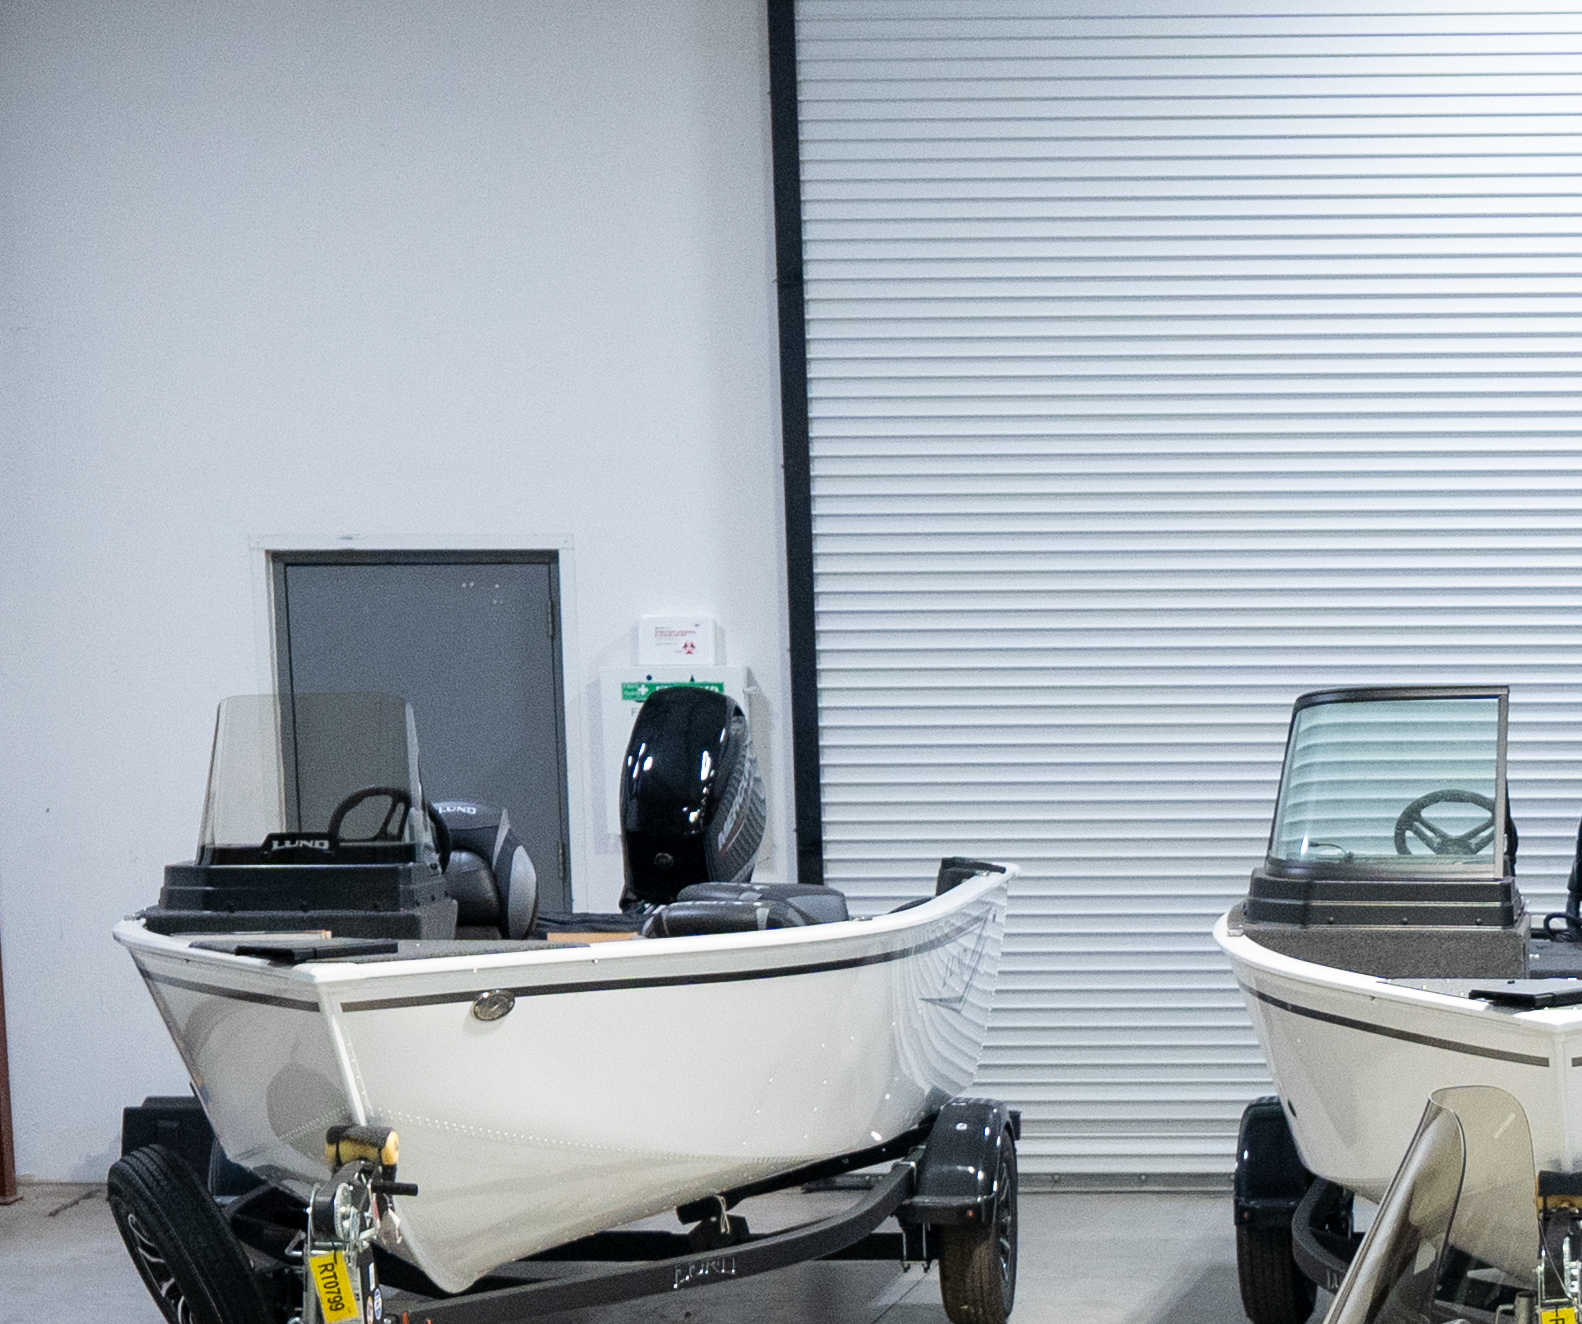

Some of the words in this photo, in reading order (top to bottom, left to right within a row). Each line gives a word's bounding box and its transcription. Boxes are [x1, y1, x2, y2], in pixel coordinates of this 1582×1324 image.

[438, 805, 476, 815] LUND
[271, 839, 329, 851] LUND
[318, 1262, 345, 1312] RT0799
